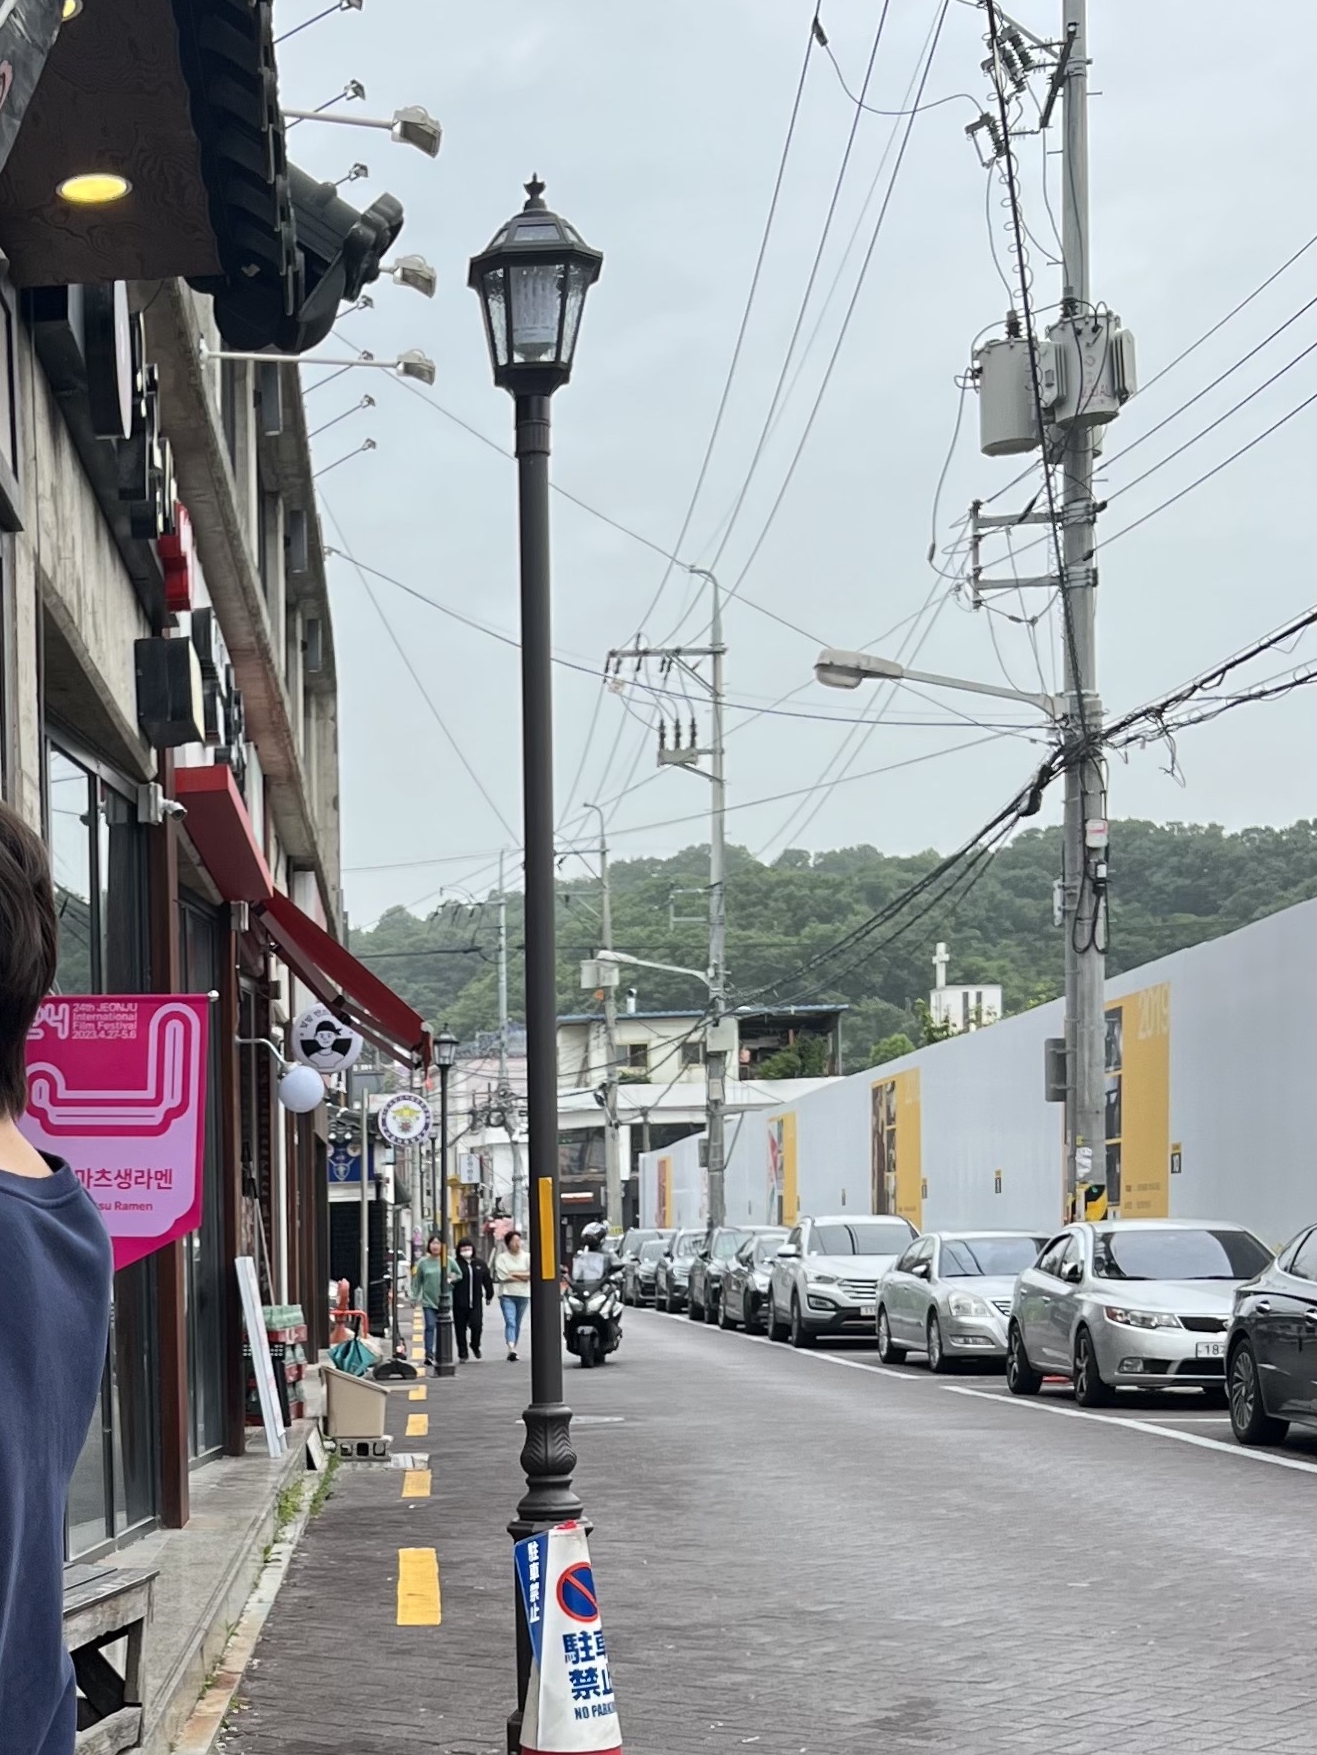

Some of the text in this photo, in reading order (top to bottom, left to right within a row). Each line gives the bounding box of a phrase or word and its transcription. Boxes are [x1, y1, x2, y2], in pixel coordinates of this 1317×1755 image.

[72, 1002, 138, 1013] 24th JEONJU
[72, 1012, 138, 1022] International
[72, 1020, 138, 1031] Film Festival
[75, 1168, 173, 1190] 마츠생라멘
[98, 1201, 154, 1211] su Ramen
[574, 1706, 590, 1720] NO
